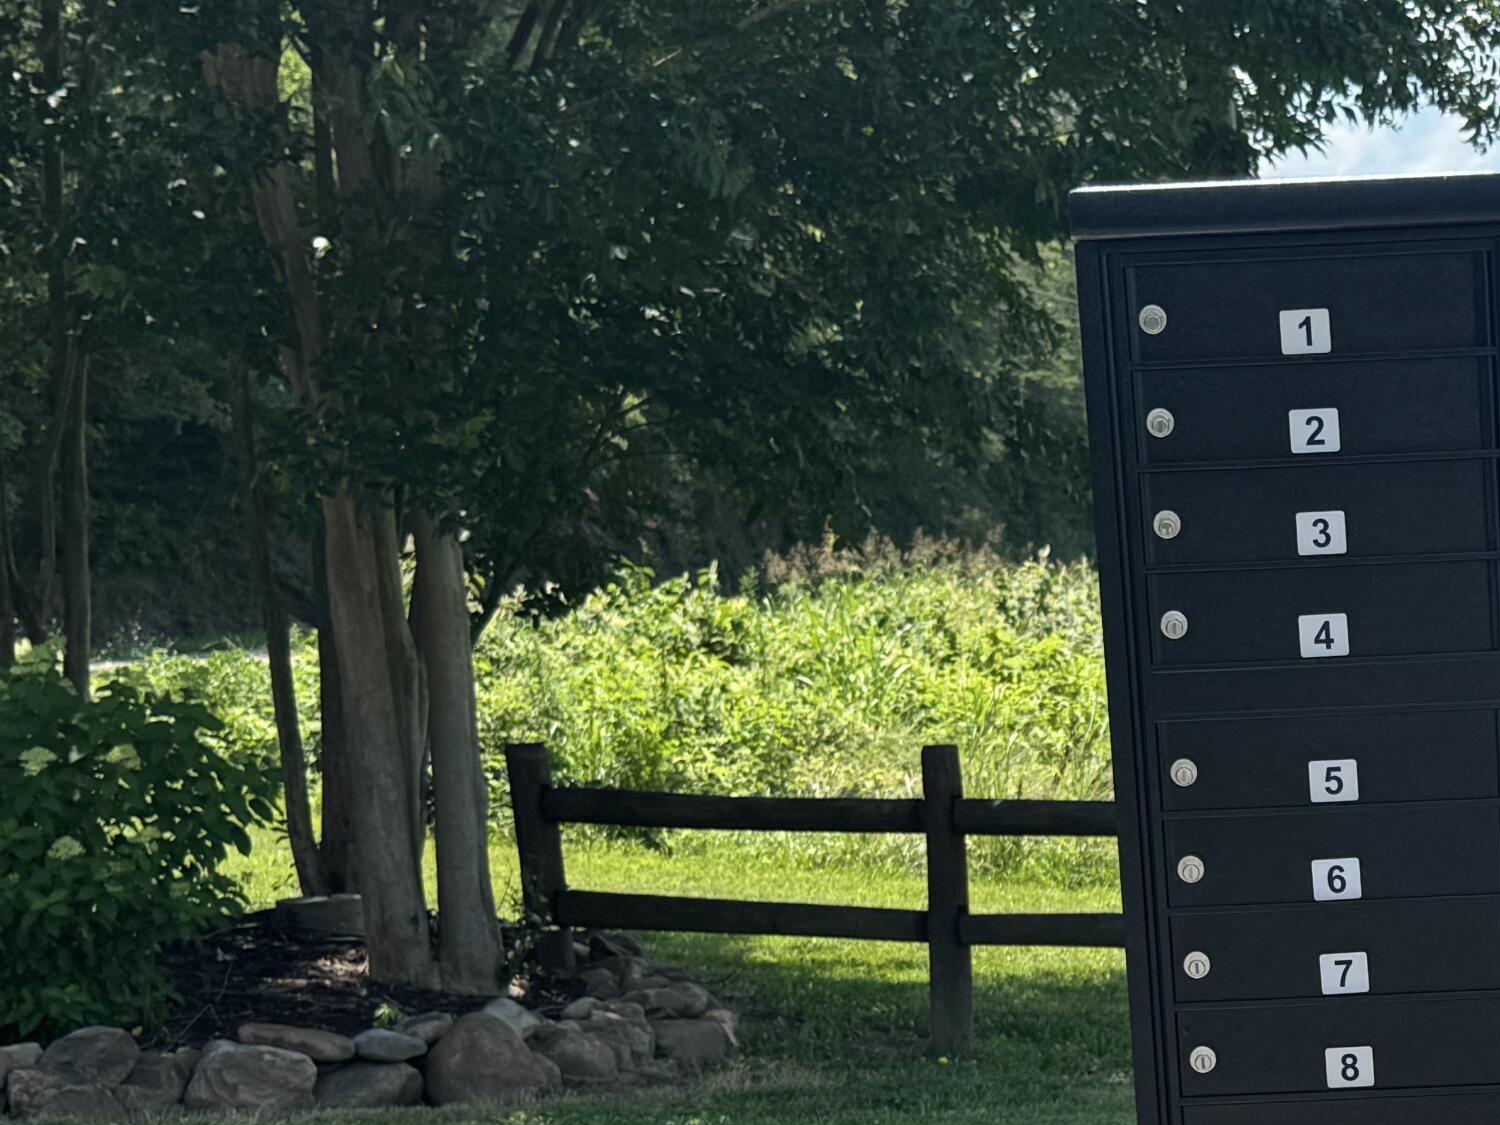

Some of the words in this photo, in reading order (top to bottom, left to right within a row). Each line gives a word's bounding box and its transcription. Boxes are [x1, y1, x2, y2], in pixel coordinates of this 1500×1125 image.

[1299, 316, 1312, 346] 1
[1306, 416, 1325, 446] 2
[1313, 519, 1331, 547] 3
[1314, 621, 1334, 649] 4
[1325, 767, 1343, 794] 5
[1328, 865, 1346, 893] 6
[1335, 960, 1352, 987] 7
[1341, 1054, 1359, 1081] 8
